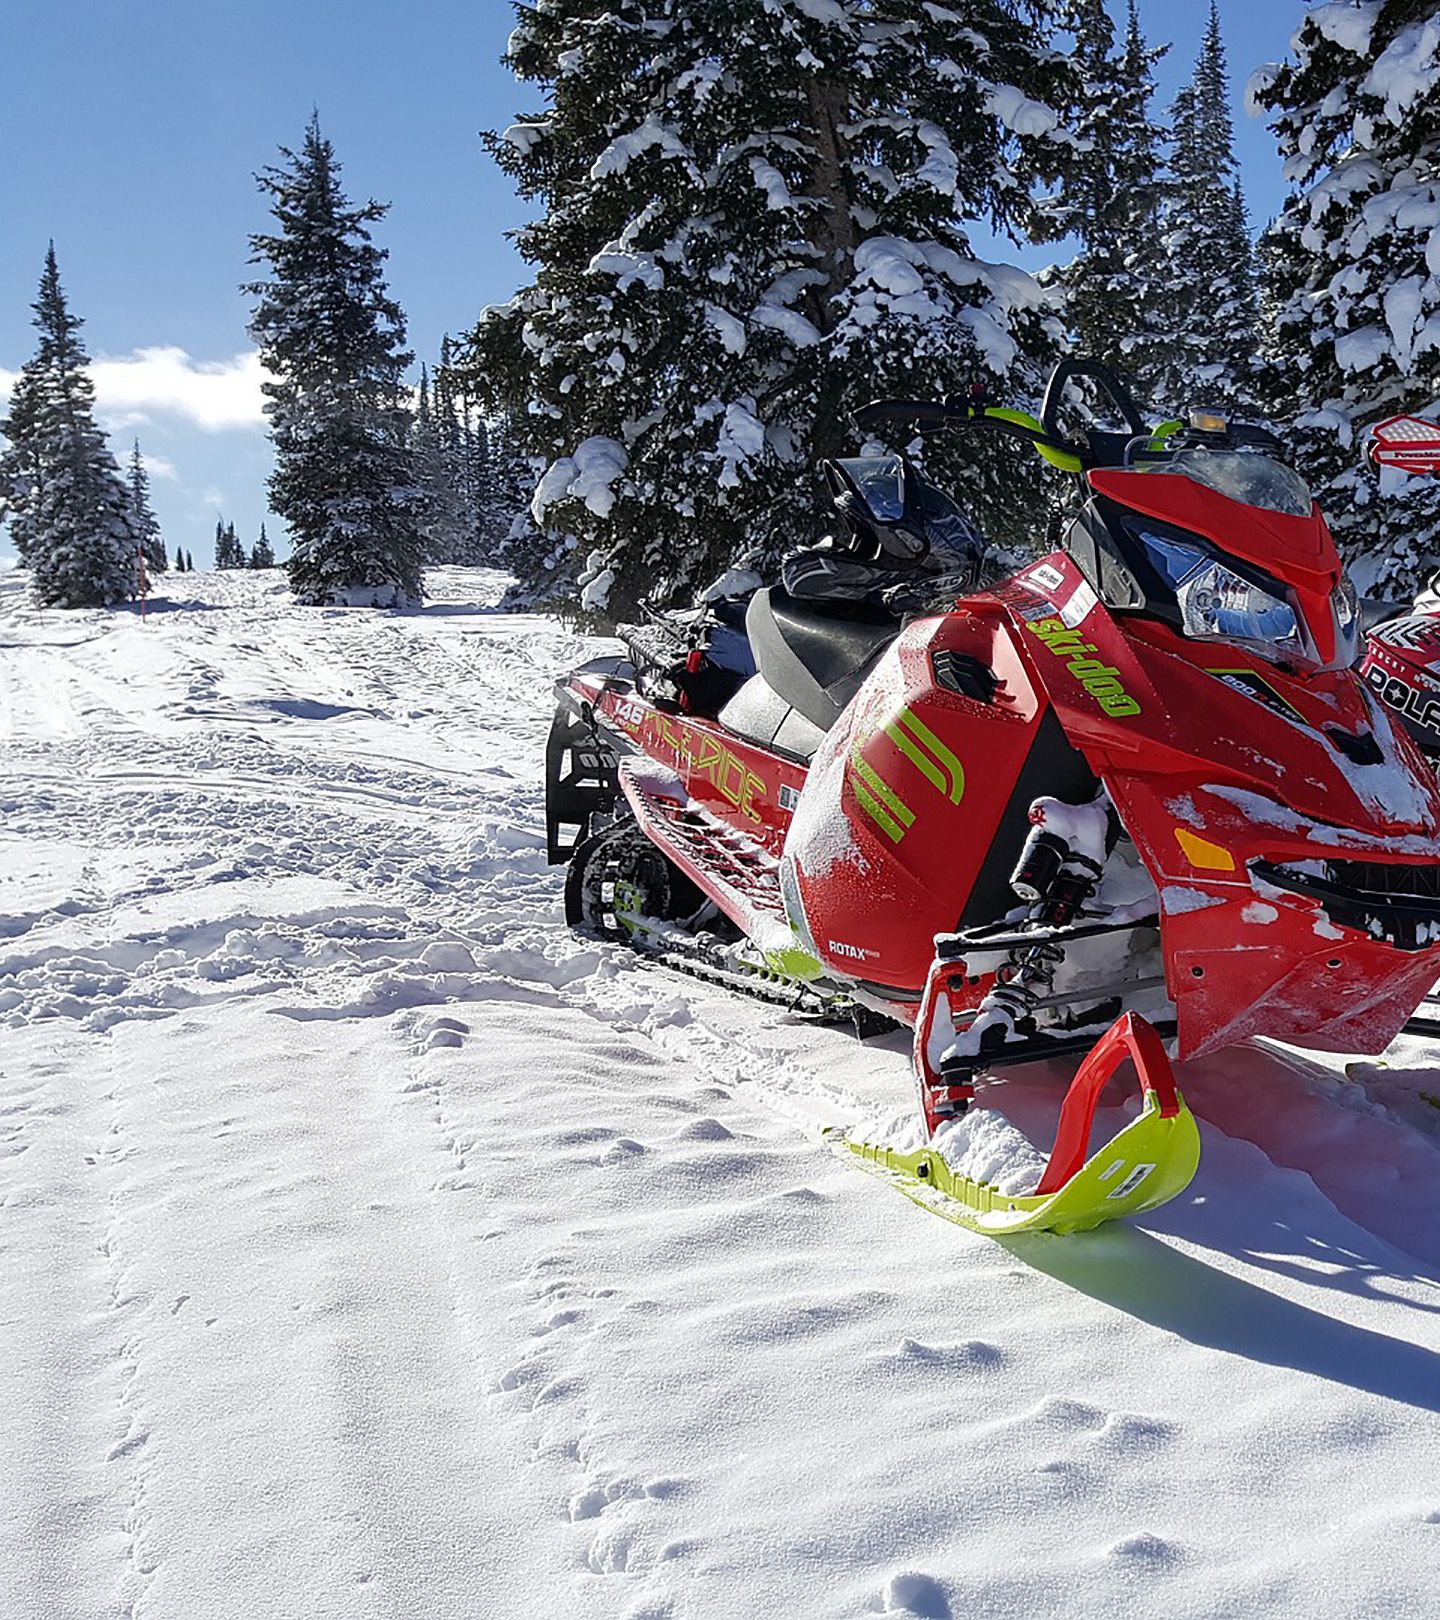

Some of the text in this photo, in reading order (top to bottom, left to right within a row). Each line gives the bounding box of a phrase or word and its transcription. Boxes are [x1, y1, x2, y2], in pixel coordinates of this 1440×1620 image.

[1025, 618, 1142, 718] ski-doo
[614, 700, 645, 726] 146
[828, 940, 866, 960] ROTAX
